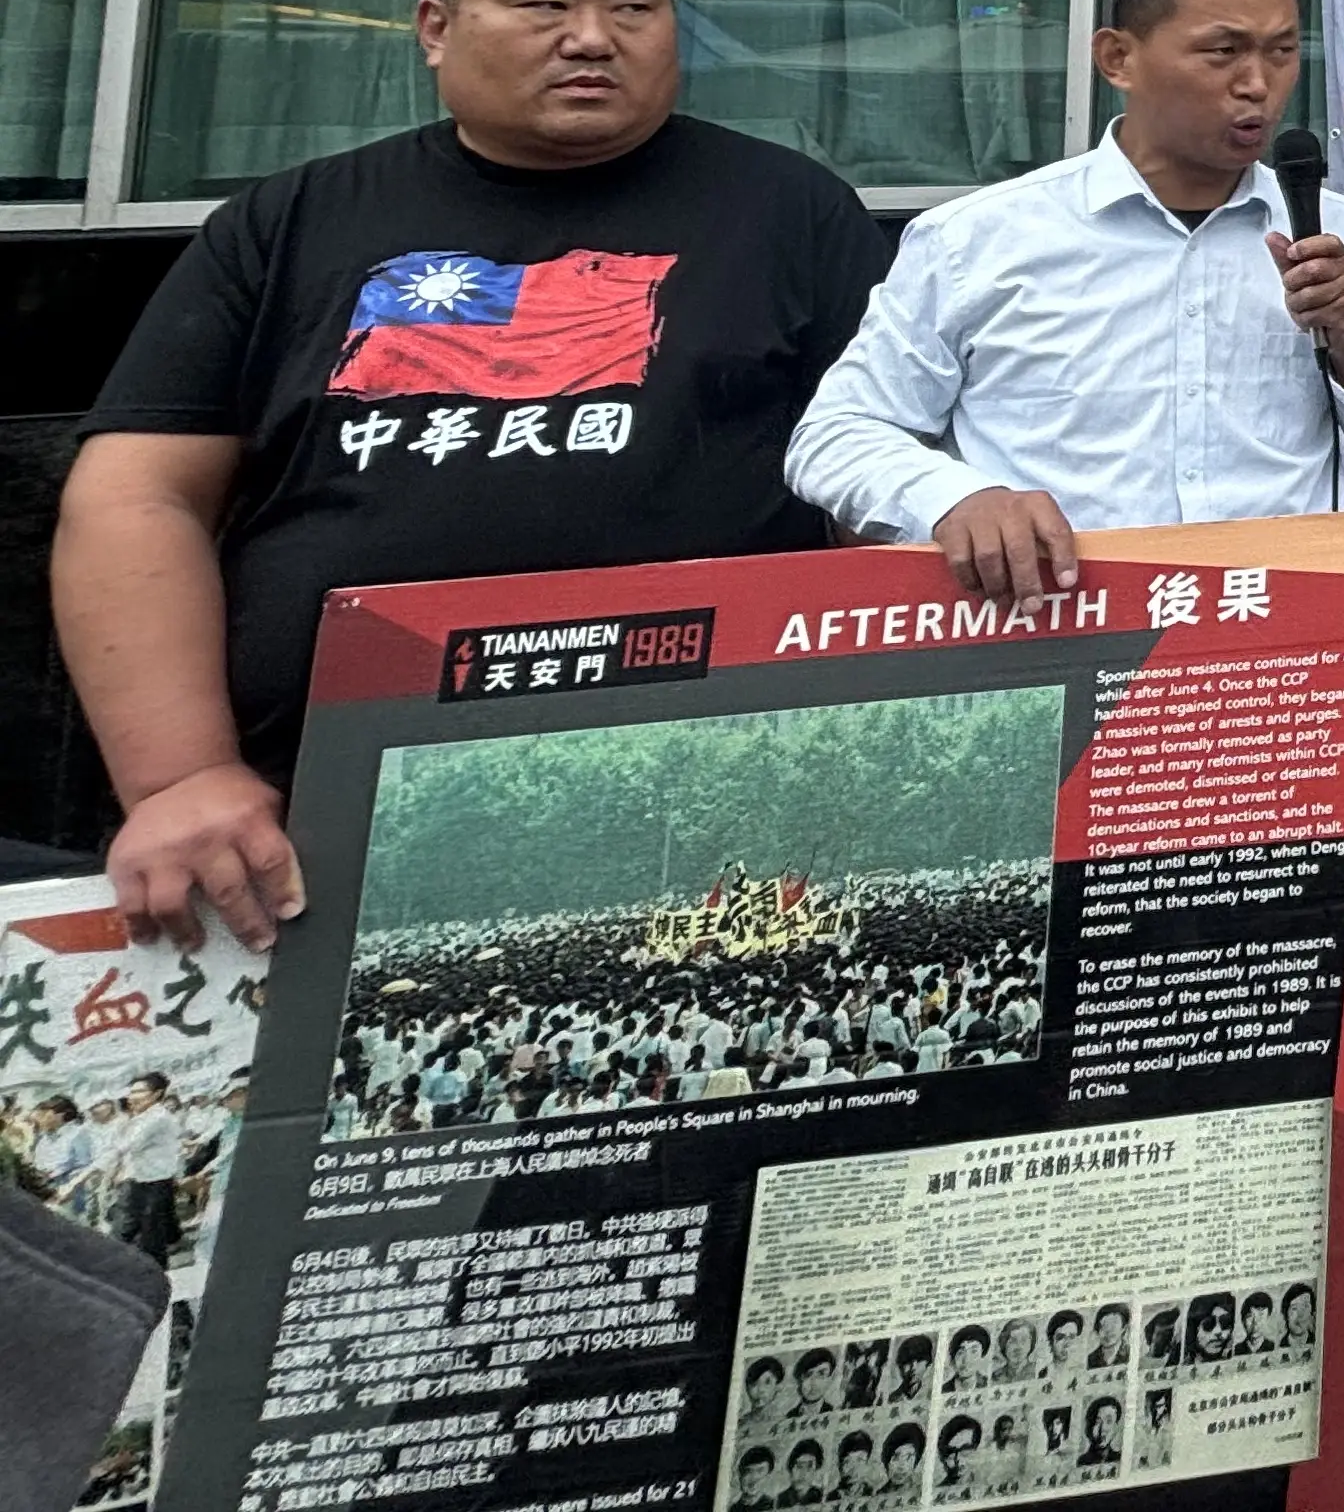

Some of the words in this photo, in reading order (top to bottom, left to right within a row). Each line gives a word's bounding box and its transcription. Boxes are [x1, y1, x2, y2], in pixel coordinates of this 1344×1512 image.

[340, 402, 632, 471] 中華民國
[1148, 568, 1273, 629] 後果
[775, 589, 1108, 654] AFTERMATH
[481, 623, 620, 658] TIANANMEN
[623, 620, 704, 668] 1989
[485, 652, 608, 690] 天安門
[1096, 667, 1182, 684] Spontaneous
[1186, 661, 1250, 674] resistance
[1253, 653, 1317, 669] continued
[1321, 651, 1339, 663] for
[1095, 688, 1131, 701] while
[1134, 685, 1165, 698] after
[1168, 683, 1199, 696] June
[1202, 680, 1214, 692] 4.
[1218, 678, 1253, 691] Once
[1256, 675, 1278, 688] the
[1281, 671, 1308, 685] CCP
[1094, 705, 1160, 719] hardliners
[1164, 698, 1221, 716] regained
[1225, 693, 1274, 709] control,
[1278, 692, 1307, 706] they
[1093, 730, 1101, 739] a
[1105, 724, 1158, 738] massive
[1161, 721, 1195, 733] wave
[1198, 716, 1212, 730] of
[1218, 715, 1262, 728] arrests
[1265, 710, 1290, 724] and
[1294, 709, 1341, 725] purges.
[1091, 746, 1127, 758] Zhao
[1130, 744, 1157, 755] was
[1160, 737, 1214, 752] formally
[1217, 731, 1273, 747] removed
[1277, 732, 1292, 742] as
[1295, 728, 1330, 744] party
[1091, 764, 1133, 778] leader,
[1138, 759, 1164, 773] and
[1167, 759, 1204, 772] many
[1207, 751, 1272, 767] reformists
[1275, 747, 1315, 760] within
[1089, 786, 1122, 797] were
[1125, 777, 1188, 794] demoted,
[1192, 770, 1257, 787] dismissed
[1261, 771, 1276, 782] or
[1279, 763, 1339, 780] detained.
[1088, 804, 1114, 816] The
[1117, 800, 1179, 813] massacre
[1182, 795, 1215, 808] drew
[1218, 795, 1227, 805] a
[1231, 789, 1276, 803] torrent
[1280, 785, 1294, 799] of
[1087, 818, 1181, 835] denunciations
[1184, 812, 1210, 827] and
[1213, 809, 1278, 824] sanctions,
[1282, 803, 1307, 818] and
[1311, 802, 1333, 815] the
[1088, 842, 1139, 857] 10-year
[1143, 836, 1187, 850] reform
[1190, 834, 1226, 846] came
[1229, 831, 1244, 843] to
[1247, 830, 1264, 841] an
[1268, 824, 1312, 839] abrupt
[1316, 820, 1343, 834] halt.
[1084, 863, 1094, 875] It
[1098, 863, 1125, 874] was
[1128, 859, 1152, 871] not
[1155, 854, 1185, 869] until
[1189, 851, 1223, 867] early
[1227, 847, 1267, 862] 1992,
[1270, 844, 1306, 858] when
[314, 1154, 338, 1170] On
[381, 1147, 396, 1163] 9,
[438, 1139, 456, 1156] of
[543, 1127, 594, 1147] gather
[596, 1123, 612, 1137] in
[615, 1115, 678, 1135] People's
[681, 1111, 734, 1129] Square
[738, 1107, 752, 1120] in
[755, 1097, 824, 1118] Shanghai
[828, 1095, 842, 1109] in
[846, 1088, 919, 1107] mourning.
[592, 1486, 643, 1510] issued
[646, 1483, 669, 1502] for
[673, 1479, 697, 1499] 21
